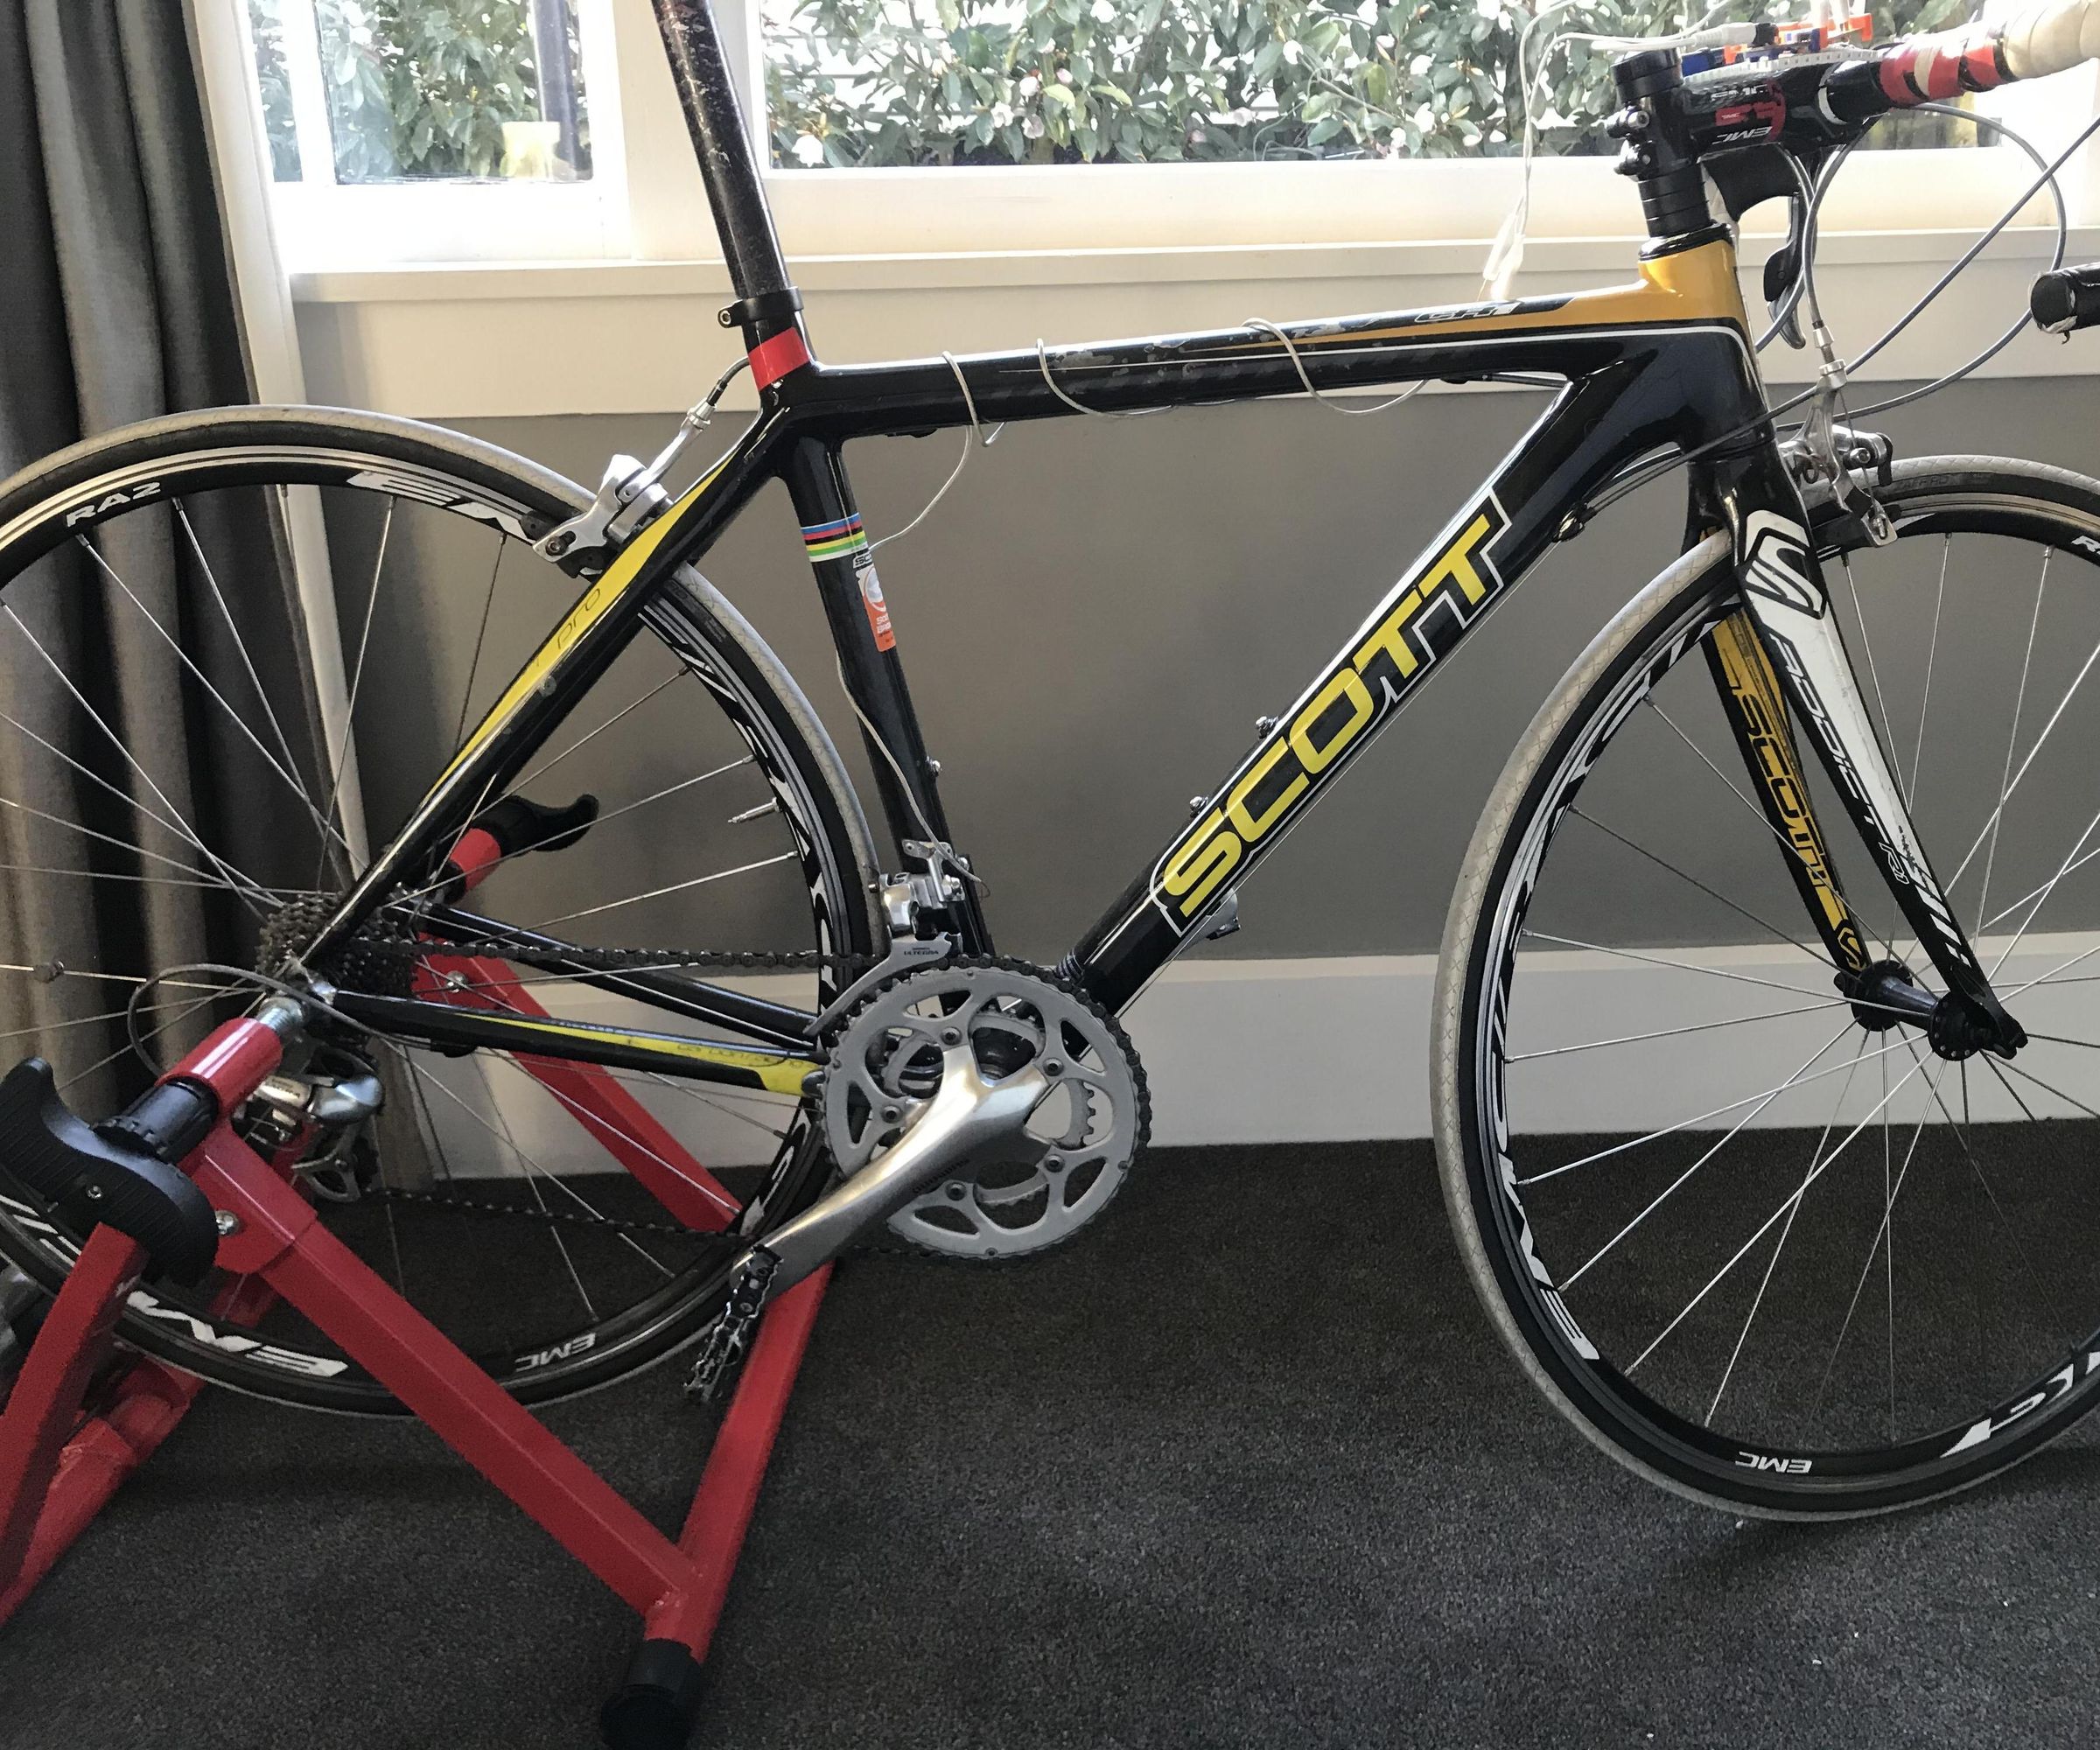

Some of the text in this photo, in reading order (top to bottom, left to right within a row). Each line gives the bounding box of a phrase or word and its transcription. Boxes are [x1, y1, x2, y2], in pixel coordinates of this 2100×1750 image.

[1712, 125, 1773, 144] EMC
[66, 482, 161, 528] RA2
[557, 587, 602, 651] pro
[1163, 514, 1491, 919] SCOTT
[1734, 695, 1829, 887] SCOTT
[515, 1333, 596, 1372] EMC
[1736, 1452, 1813, 1474] EMC
